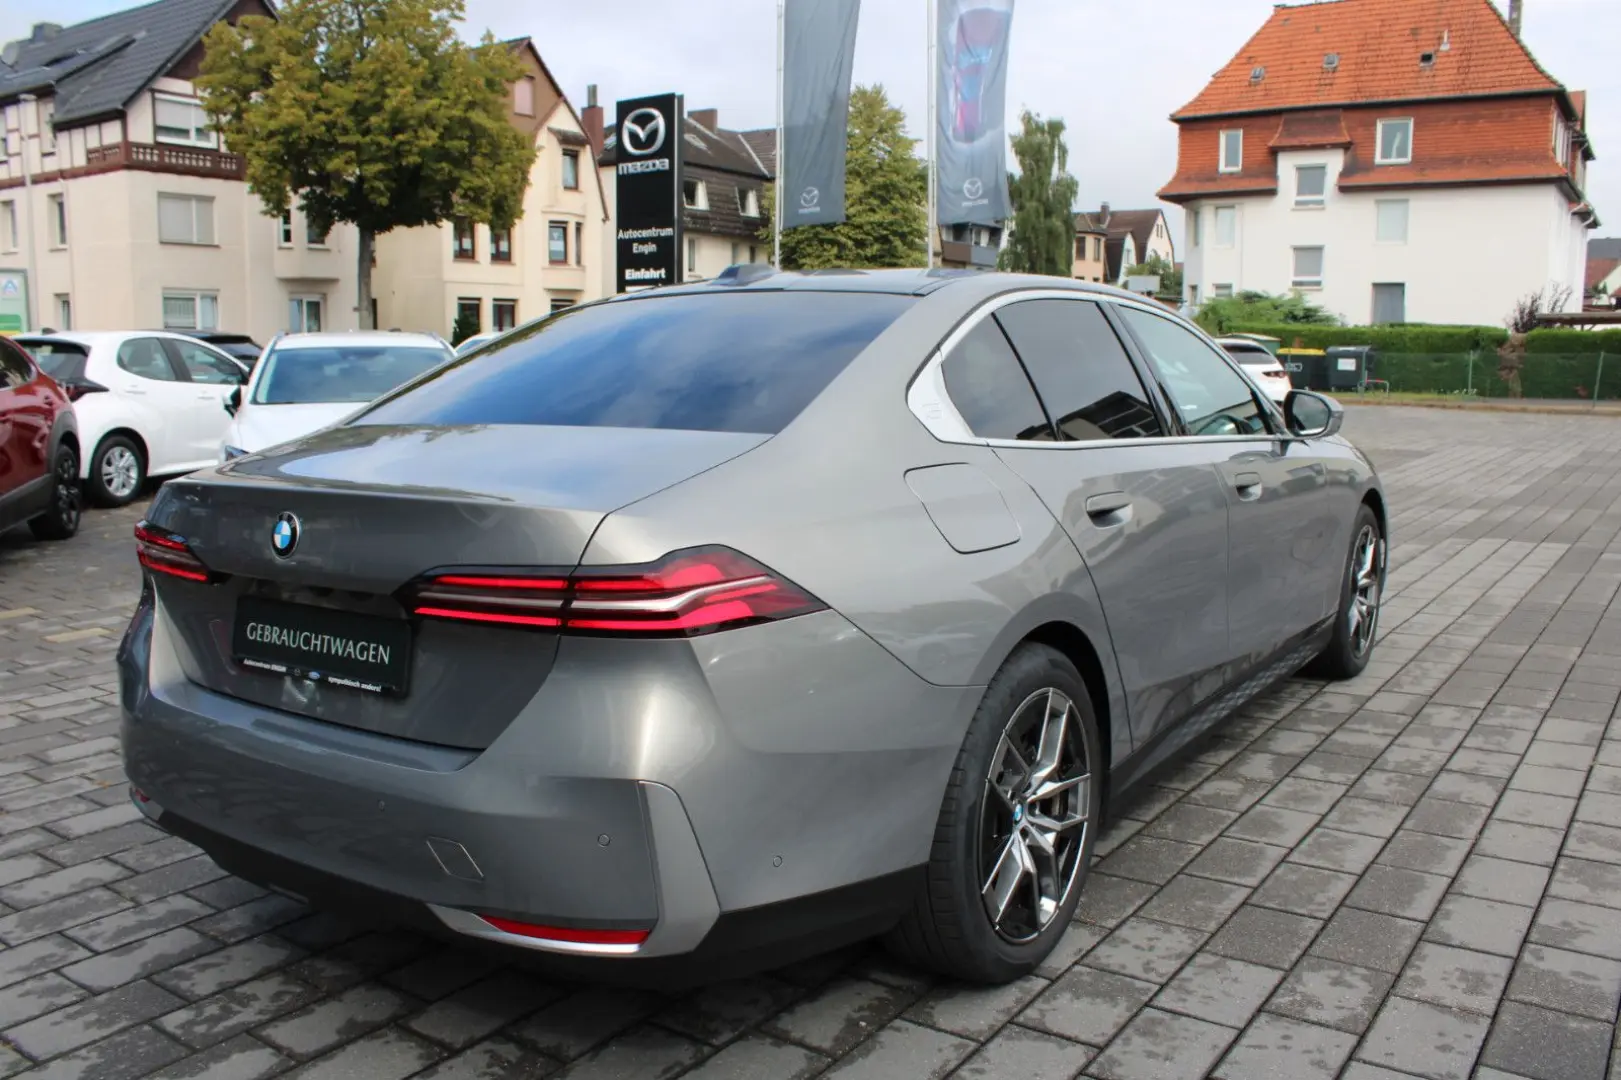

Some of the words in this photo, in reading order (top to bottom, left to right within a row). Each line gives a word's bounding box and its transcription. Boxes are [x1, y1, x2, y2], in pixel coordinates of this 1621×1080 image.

[617, 227, 673, 239] Autocentrum
[632, 242, 657, 255] Engin
[625, 268, 666, 280] Einfahrt
[246, 622, 390, 665] GEBRAUCHTWAGEN
